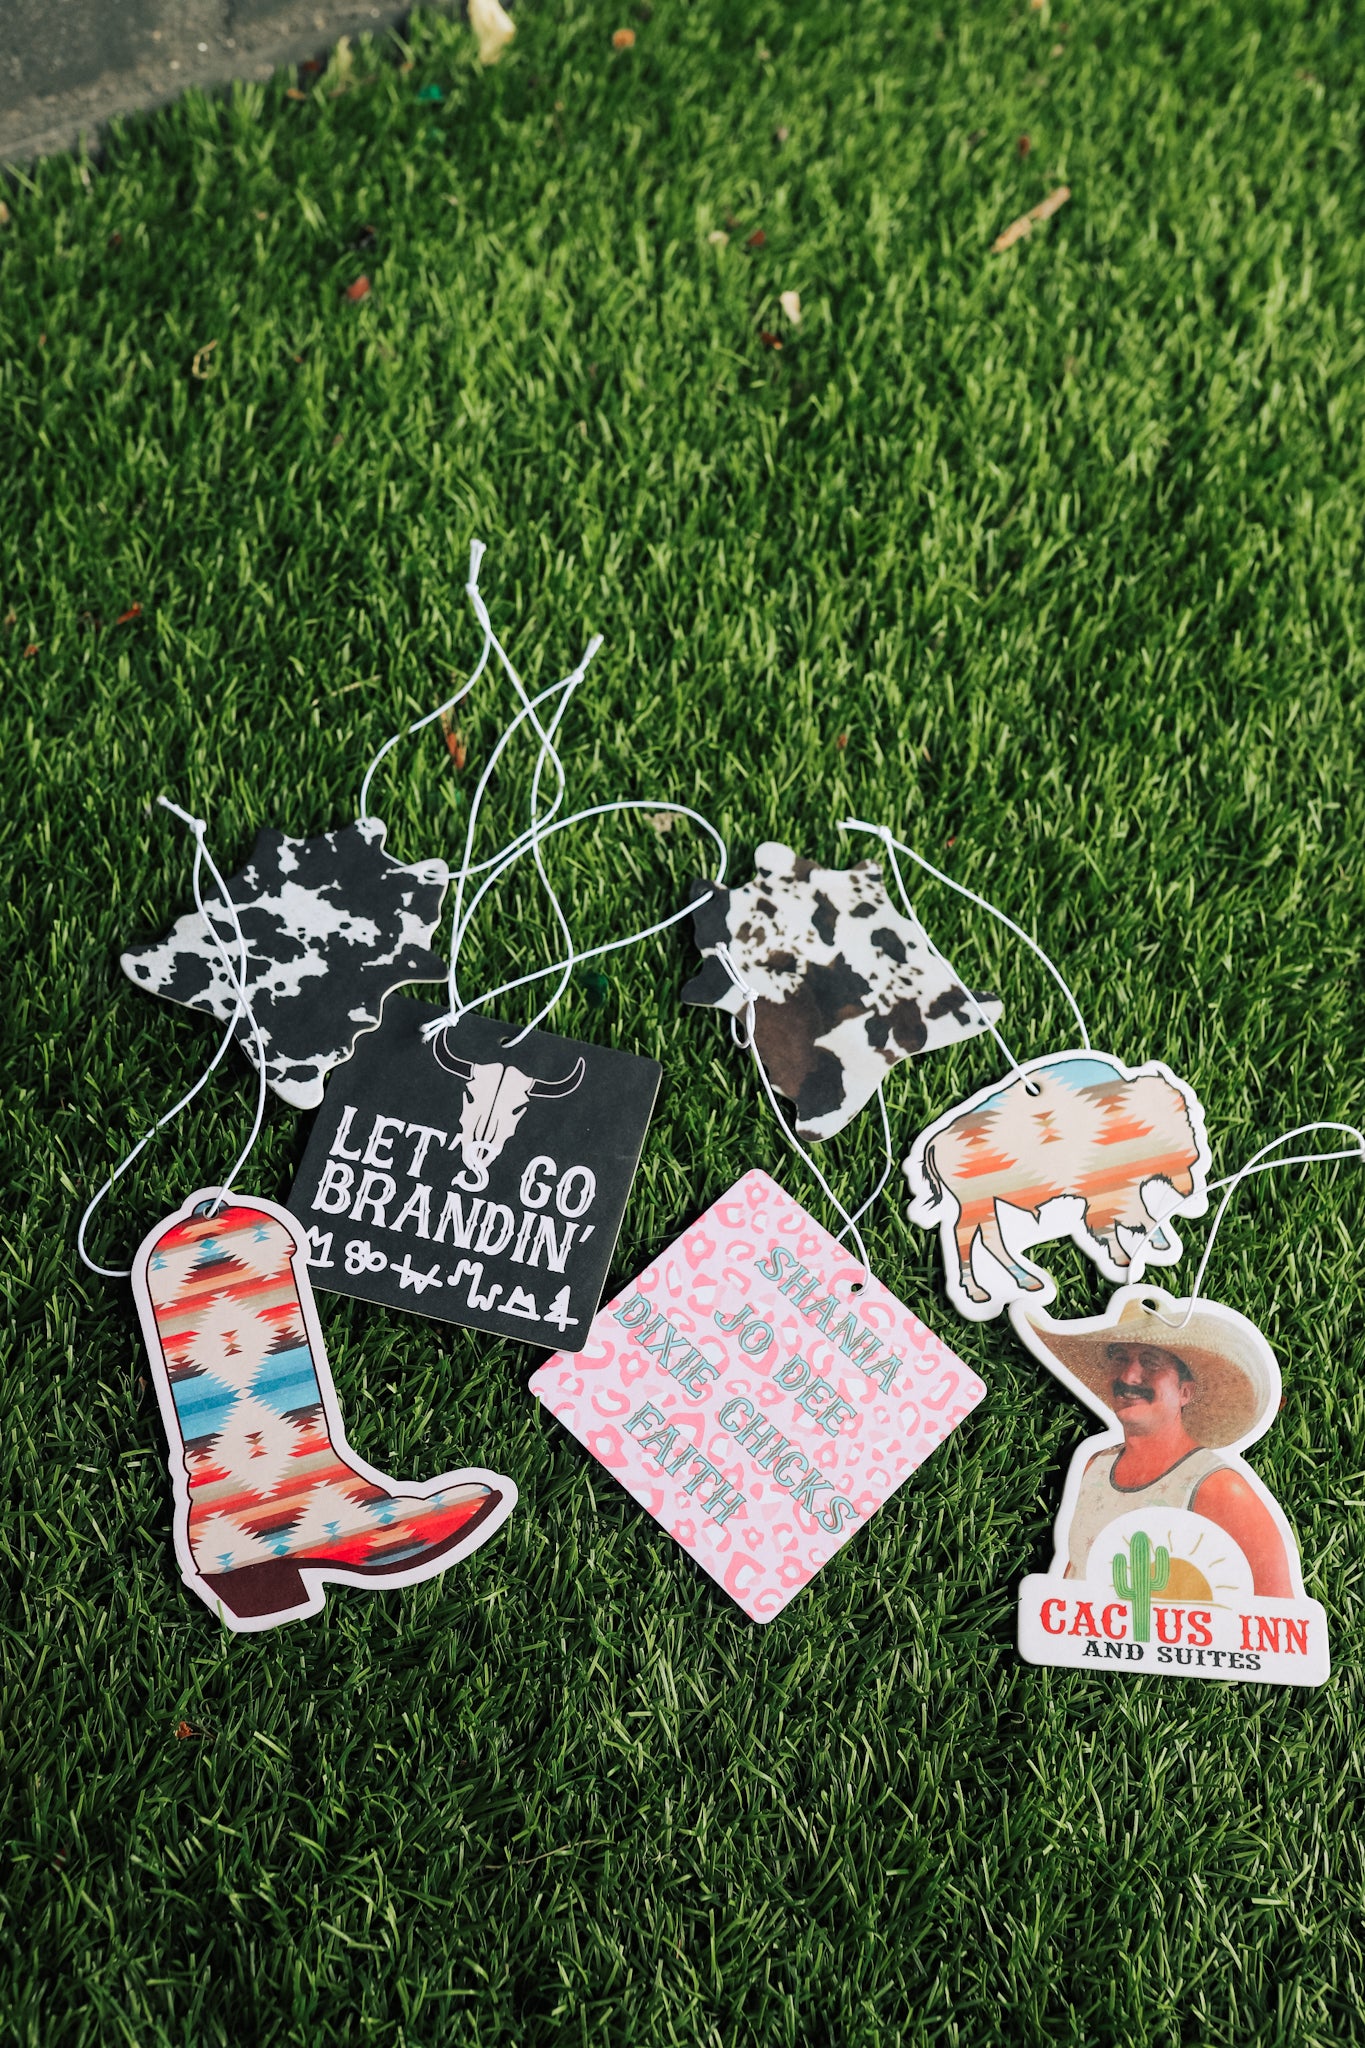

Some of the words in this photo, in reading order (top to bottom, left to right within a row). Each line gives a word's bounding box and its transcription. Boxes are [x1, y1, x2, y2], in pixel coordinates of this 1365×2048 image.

[310, 1159, 596, 1274] BRANDIN'
[328, 1105, 500, 1192] LET'S
[519, 1155, 597, 1219] GO
[714, 1303, 775, 1356] JO
[772, 1353, 858, 1437] DEE
[753, 1246, 904, 1396] SHANIA
[612, 1293, 721, 1399] DIXIE
[718, 1396, 861, 1535] CHICKS
[622, 1401, 748, 1528] FAITH
[1082, 1640, 1145, 1661] AND
[1157, 1646, 1262, 1671] SUITES
[1238, 1614, 1310, 1656] INN
